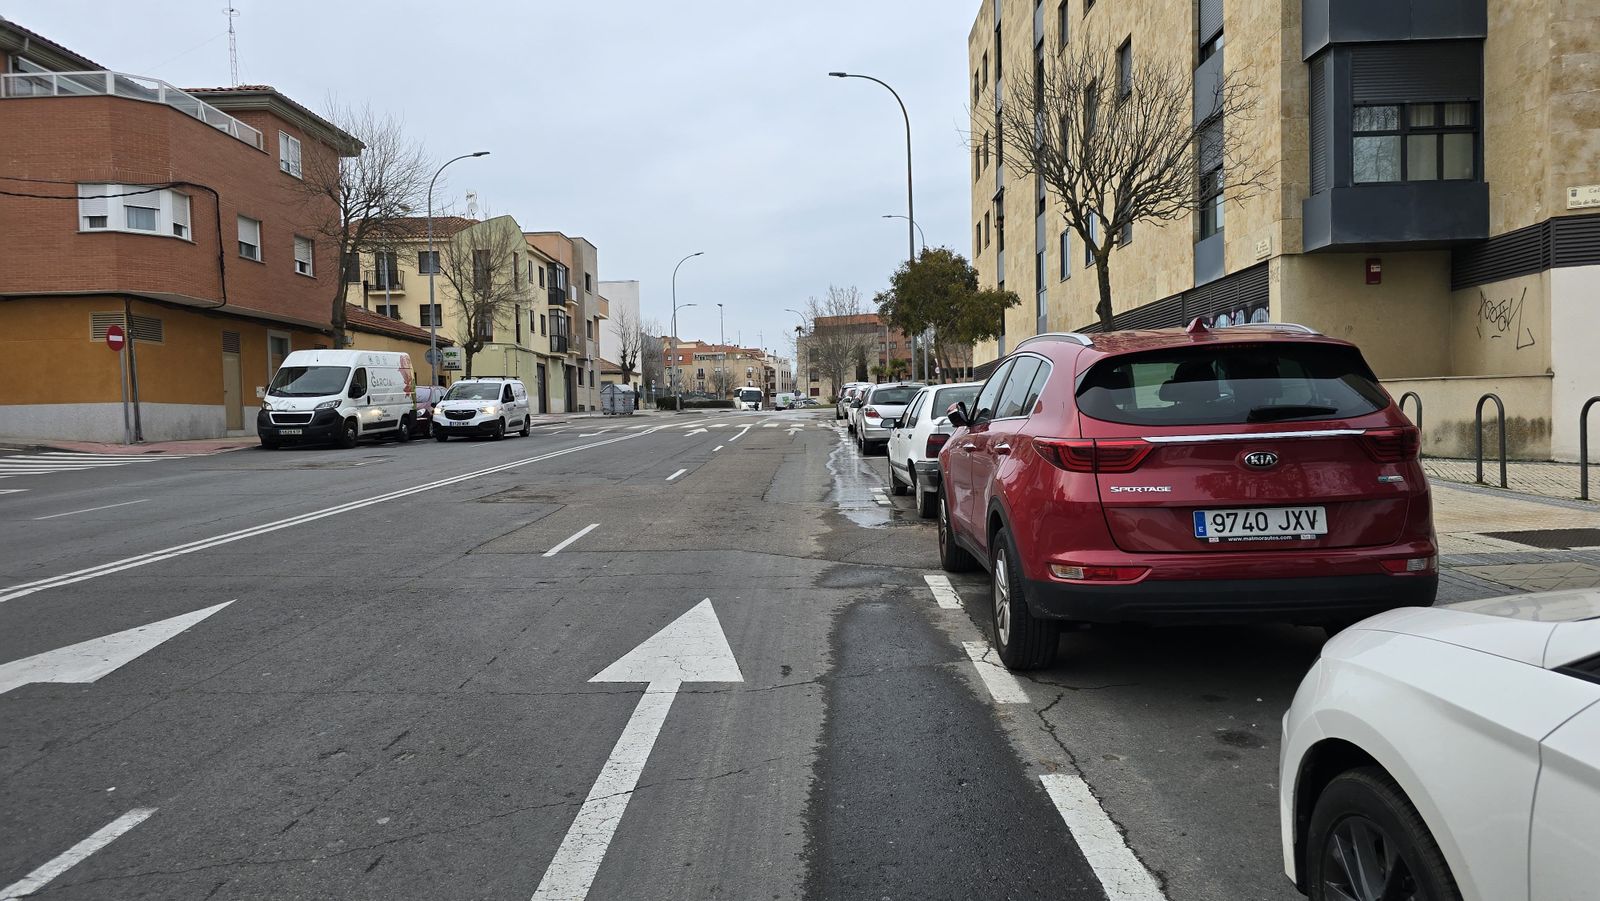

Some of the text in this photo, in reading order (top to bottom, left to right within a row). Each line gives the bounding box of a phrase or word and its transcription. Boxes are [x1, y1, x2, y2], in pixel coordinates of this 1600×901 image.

[1249, 454, 1274, 465] KIA
[1212, 511, 1269, 533] 9740
[1278, 510, 1317, 531] JXV
